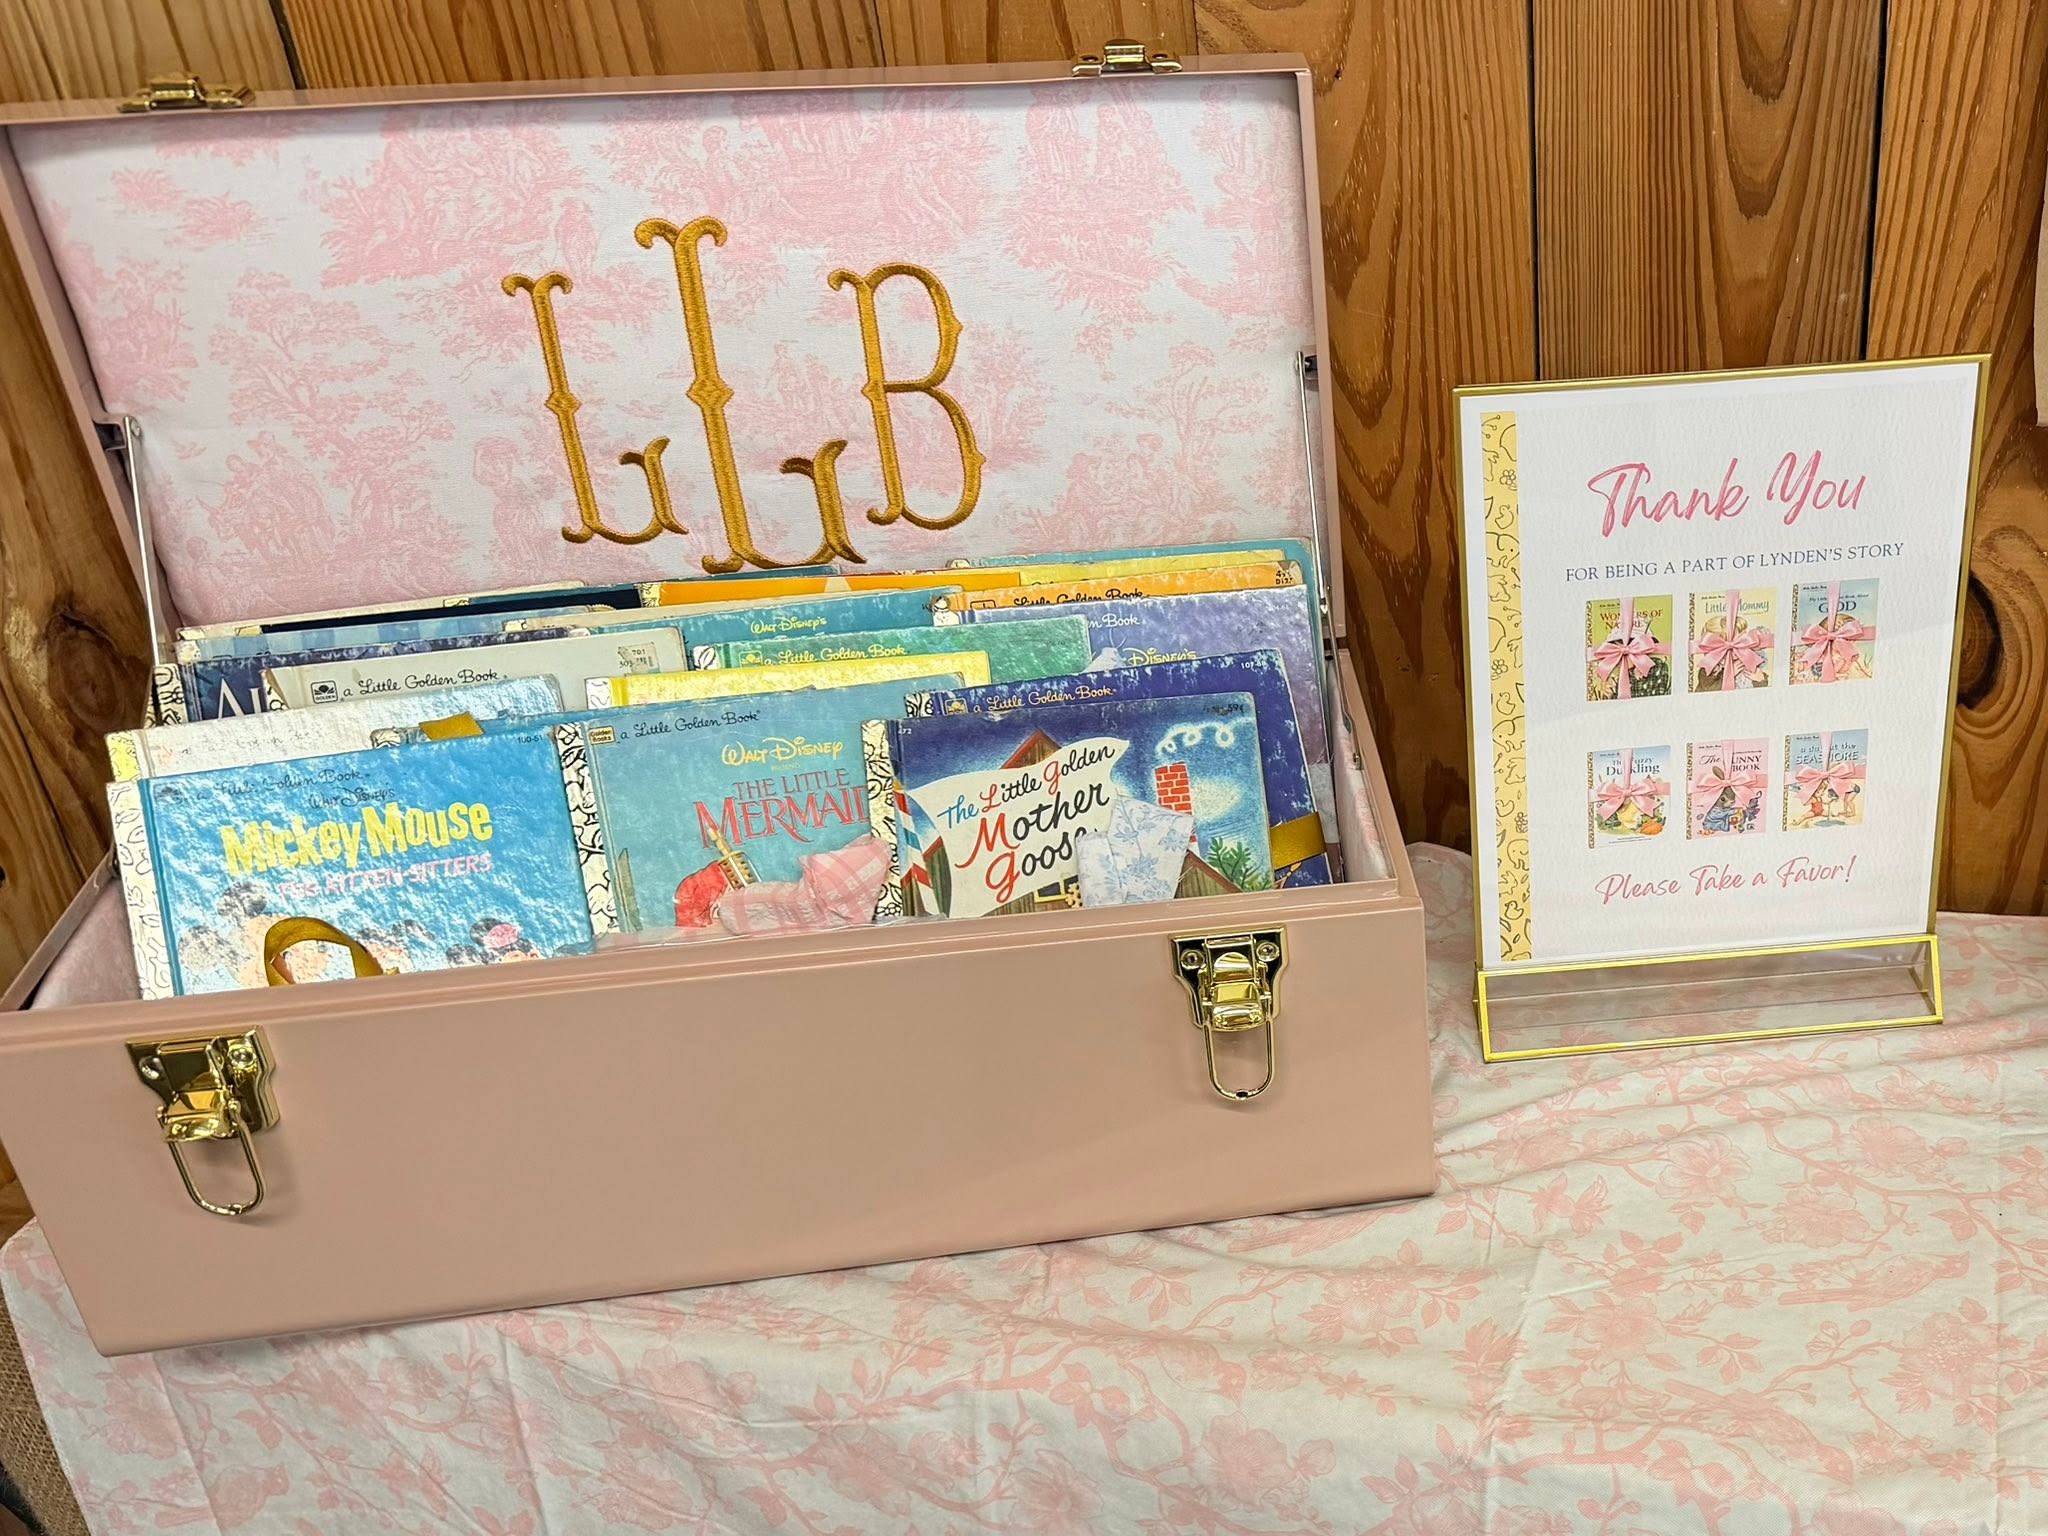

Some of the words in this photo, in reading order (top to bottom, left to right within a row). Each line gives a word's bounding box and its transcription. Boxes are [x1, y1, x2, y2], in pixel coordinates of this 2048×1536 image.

[1587, 457, 1750, 538] Thank
[1766, 449, 1867, 526] You
[1565, 566, 1599, 582] FOR
[1605, 562, 1659, 580] BEING
[1663, 560, 1676, 575] A
[1682, 556, 1728, 573] PART
[1732, 554, 1756, 570] OF
[1759, 547, 1843, 568] LYNDEN'S
[1847, 542, 1905, 560] STORY
[1102, 613, 1140, 629] Book
[1705, 602, 1727, 614] Little
[779, 650, 816, 665] Little
[820, 645, 868, 661] Golden
[868, 643, 907, 657] Book
[343, 688, 353, 697] a
[358, 678, 402, 695] Little
[404, 673, 458, 690] Golden
[457, 668, 499, 683] Book
[973, 705, 982, 713] a
[986, 695, 1025, 711] Little
[1028, 690, 1076, 706] Golden
[1075, 685, 1113, 700] Book
[620, 731, 630, 740] a
[633, 722, 671, 738] Little
[674, 716, 722, 732] Golden
[721, 711, 758, 725] Book
[1606, 763, 1660, 775] Dukling
[1699, 755, 1721, 765] The
[1732, 755, 1762, 765] UNNY
[317, 767, 364, 786] Book
[733, 777, 777, 801] THE
[781, 766, 851, 794] LITTLE
[937, 794, 980, 829] The
[979, 772, 1043, 813] Little
[219, 814, 362, 878] Mickey
[361, 801, 494, 858] Mouse
[954, 782, 1110, 869] Mother
[1594, 873, 1682, 905] Please
[1688, 863, 1745, 897] Take
[1751, 871, 1768, 887] a
[1776, 854, 1858, 888] Favor!
